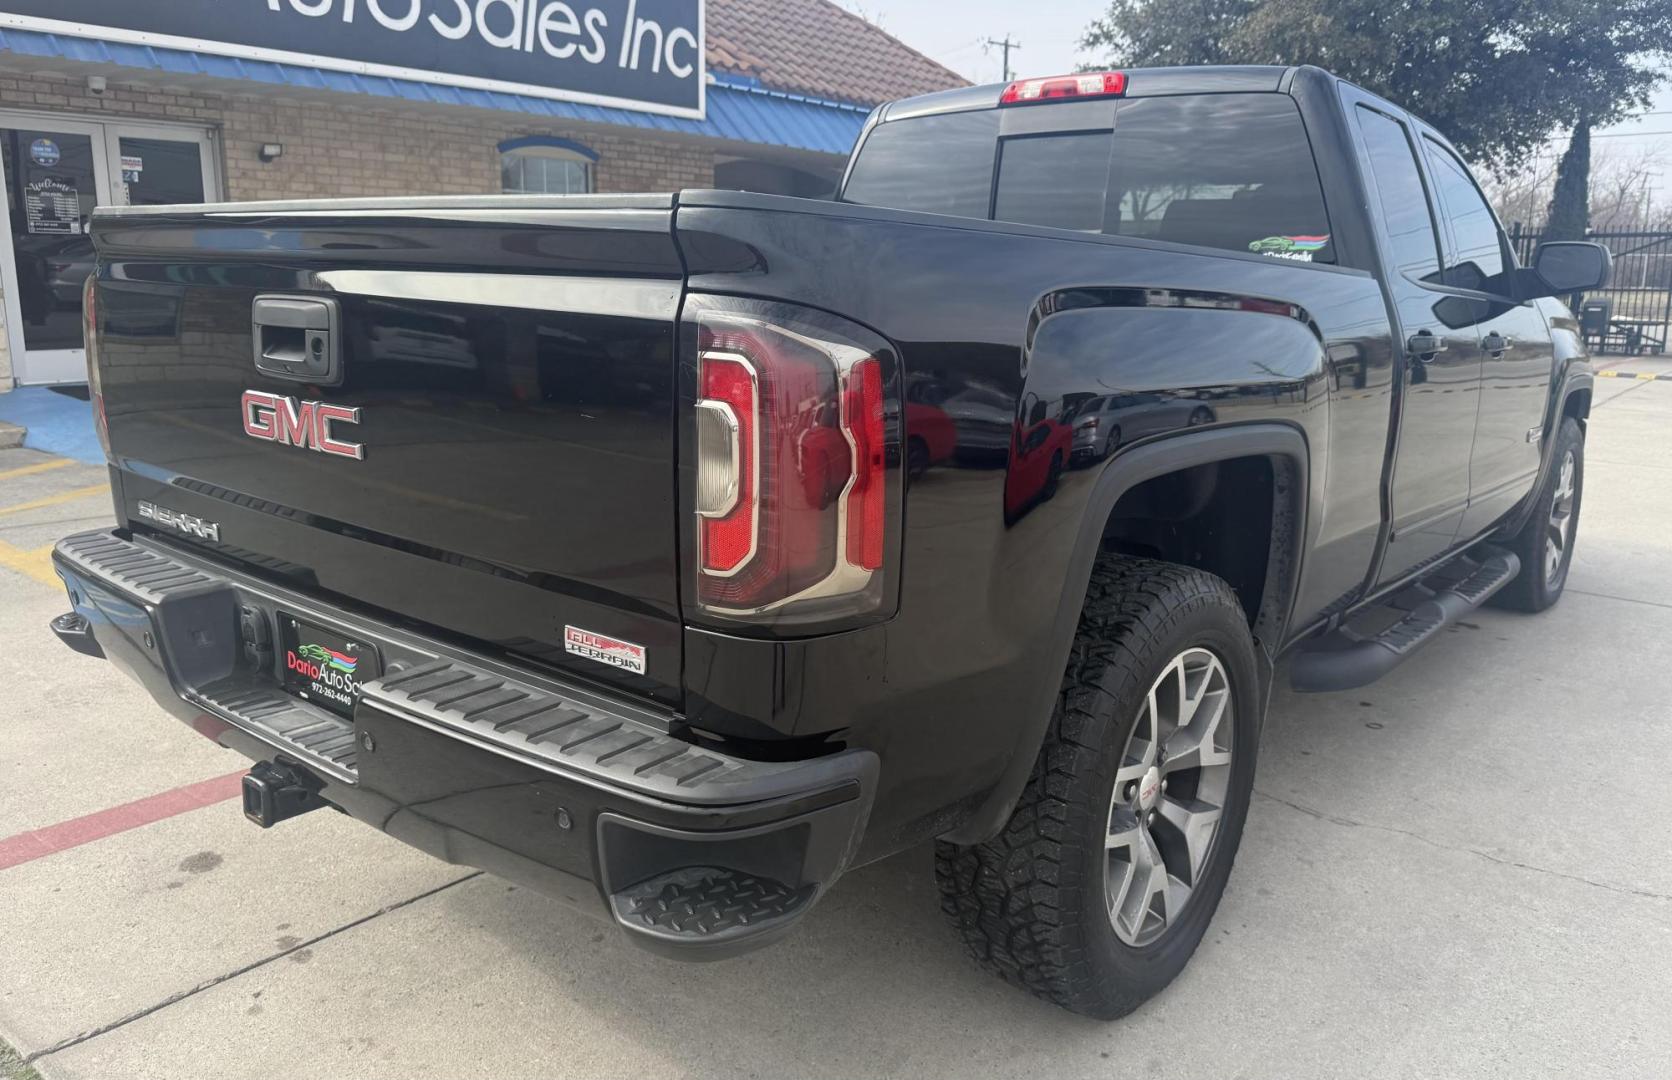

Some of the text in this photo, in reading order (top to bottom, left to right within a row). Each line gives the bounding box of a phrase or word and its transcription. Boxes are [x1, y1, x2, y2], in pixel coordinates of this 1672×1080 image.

[618, 0, 698, 78] Inc
[241, 389, 363, 461] GMC
[138, 500, 219, 542] SIERRA
[567, 642, 641, 671] TERRAIN
[570, 630, 603, 649] ALL
[312, 682, 352, 706] 972-262-4440
